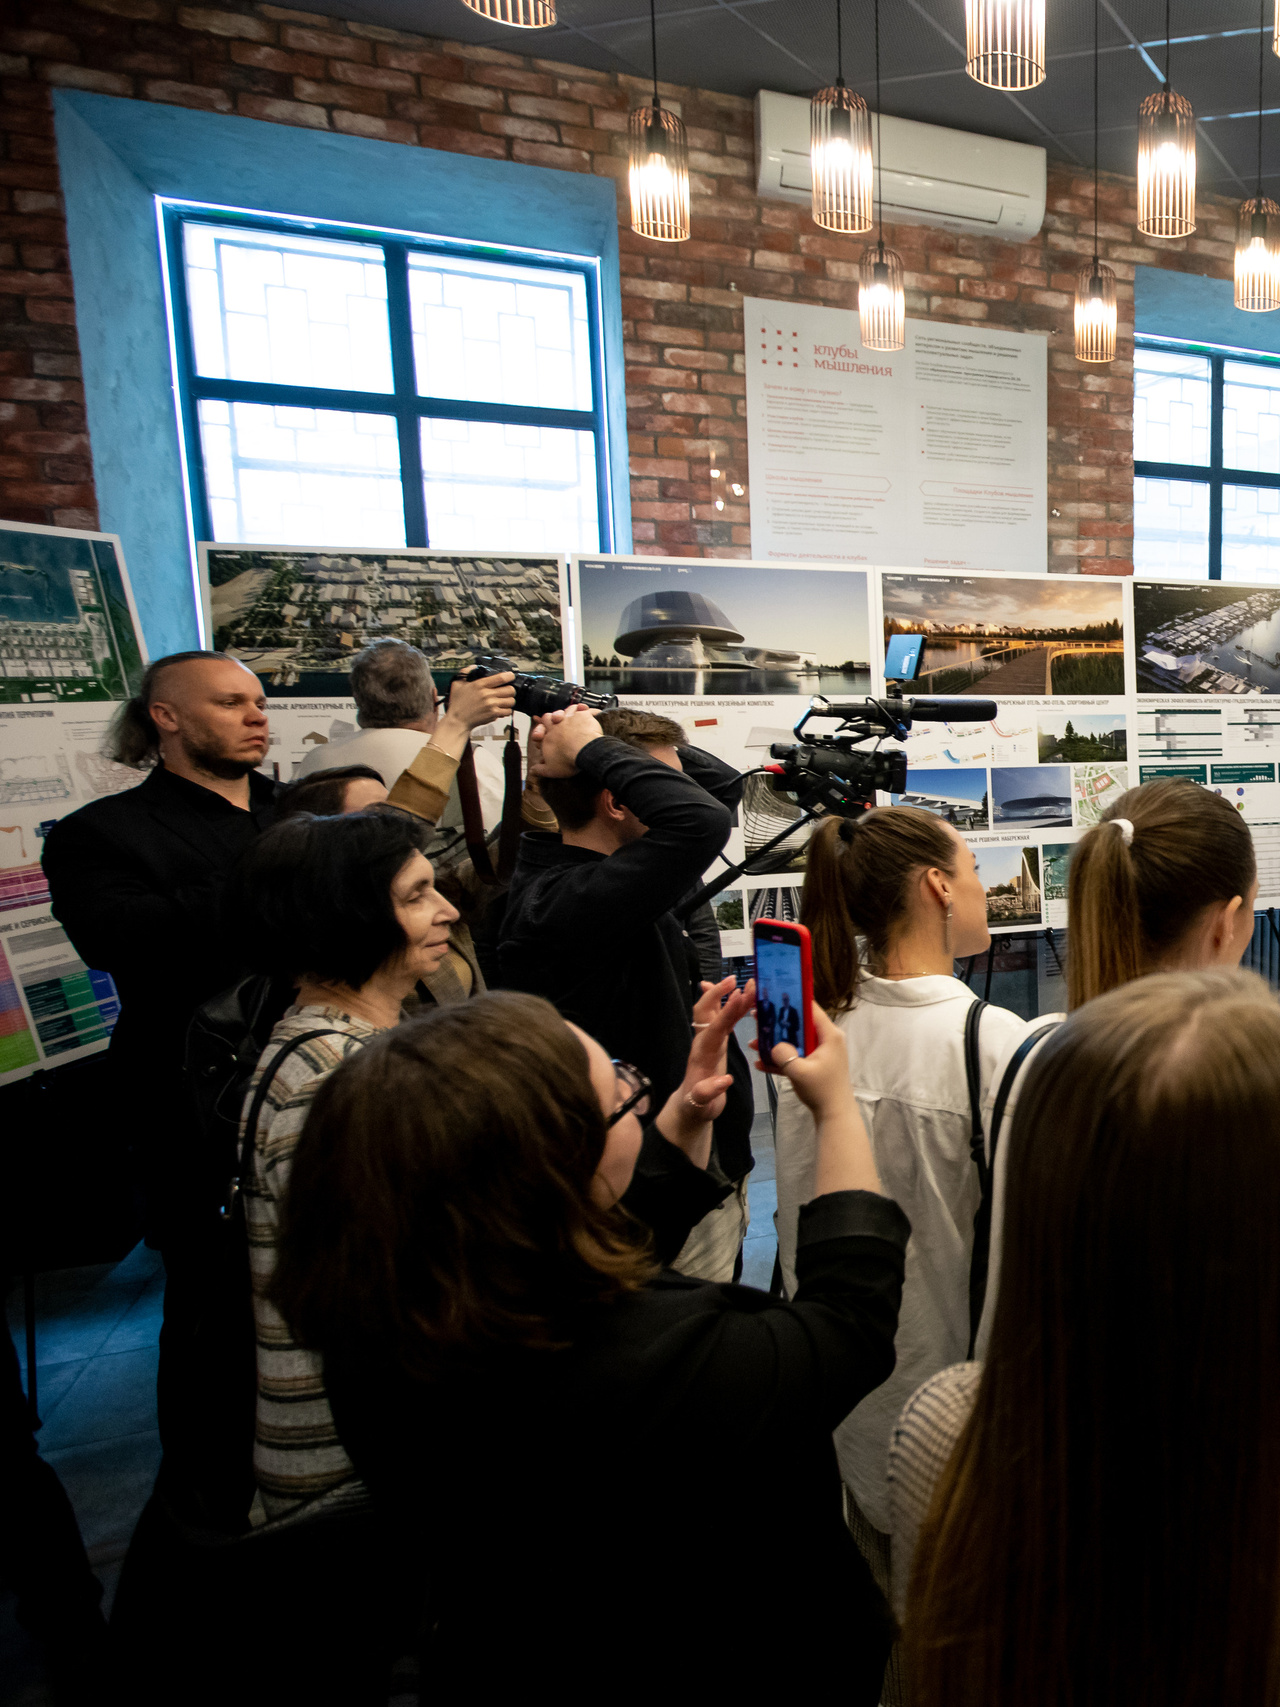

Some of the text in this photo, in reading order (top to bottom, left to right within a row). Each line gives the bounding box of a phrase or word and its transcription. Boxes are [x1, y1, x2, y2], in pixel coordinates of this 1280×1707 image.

[814, 344, 859, 360] клубы
[814, 359, 893, 376] мышления
[717, 699, 746, 707] МУЗЕЙНЫЙ
